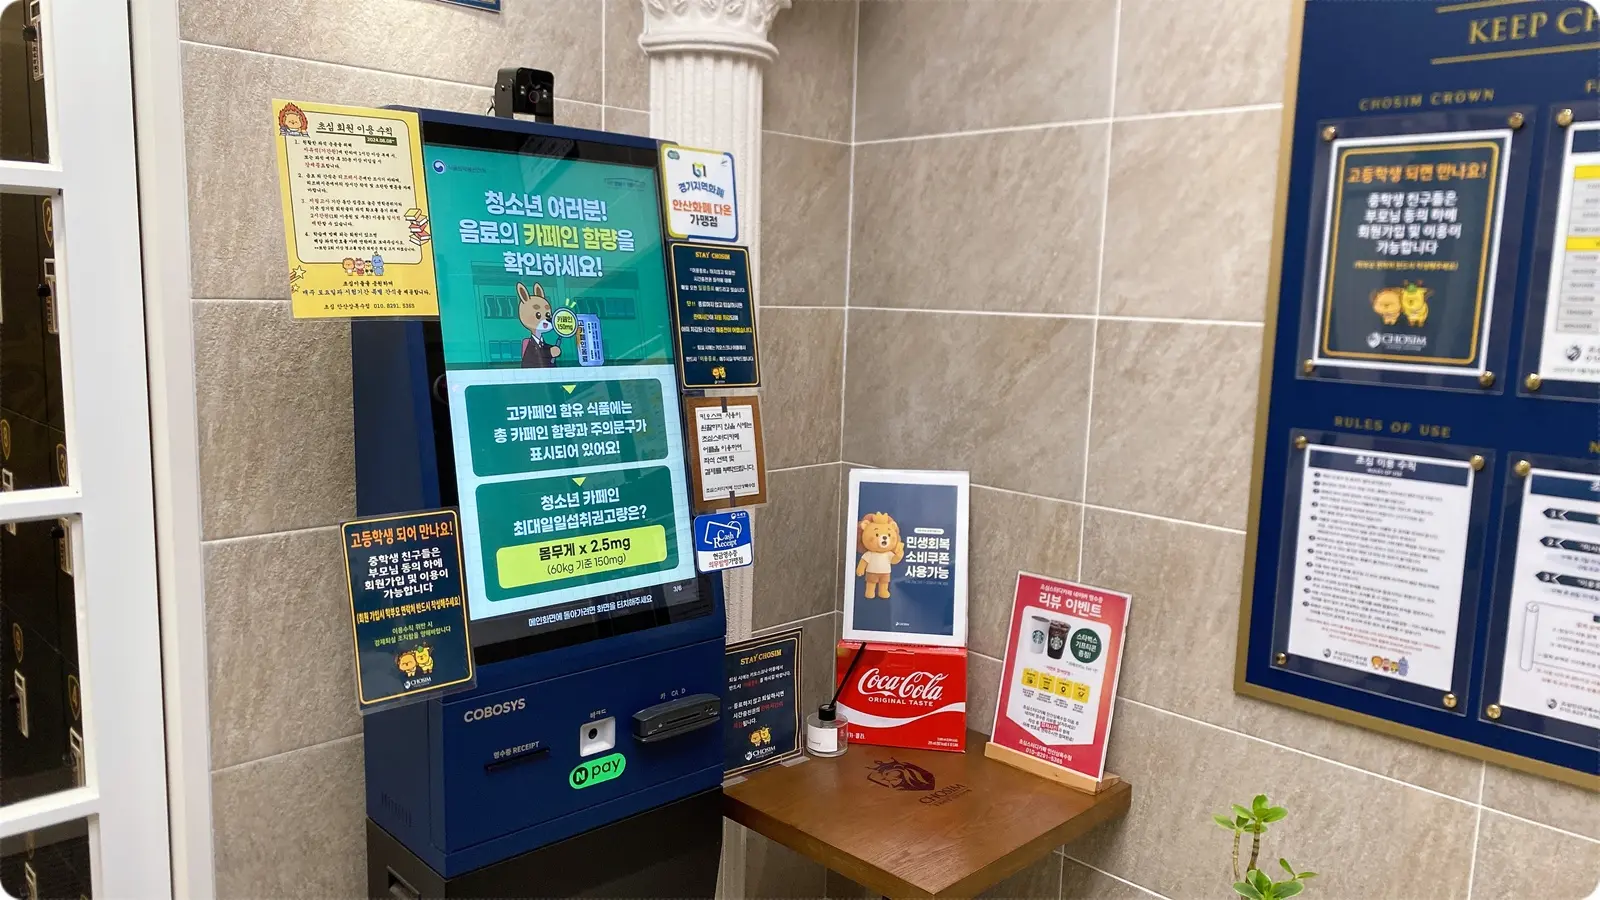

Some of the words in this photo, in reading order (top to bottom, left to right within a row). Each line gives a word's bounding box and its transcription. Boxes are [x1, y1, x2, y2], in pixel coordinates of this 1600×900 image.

[1469, 11, 1548, 44] KEEP
[1358, 94, 1423, 111] CHOSIM
[1430, 88, 1495, 105] CROWN
[317, 121, 334, 131] 초심
[336, 122, 354, 132] 회원
[357, 124, 374, 135] 이용
[1347, 164, 1401, 183] 고등학생
[1404, 163, 1433, 181] 되면
[1436, 160, 1488, 180] 만나요!
[678, 180, 725, 198] 경기지역화폐
[484, 190, 544, 218] 청소년
[548, 196, 608, 222] 여러분!
[672, 199, 712, 214] 안산화폐
[714, 204, 732, 216] 다온
[1367, 192, 1405, 208] 중학생
[1406, 190, 1458, 207] 친구들은
[690, 214, 718, 227] 가맹점
[1364, 208, 1401, 224] 부모님
[1403, 208, 1429, 223] 동의
[1430, 206, 1459, 222] 하에
[459, 218, 519, 245] 음료의
[522, 223, 580, 249] 카페인
[582, 226, 635, 252] 함량을
[1356, 224, 1406, 240] 회원가입
[1408, 224, 1421, 239] 및
[1422, 222, 1463, 239] 이용이
[1375, 239, 1438, 255] 가능합니다
[502, 250, 603, 277] 확인하세요!
[1382, 332, 1427, 346] CHOSIM
[506, 404, 557, 421] 고카페인
[559, 403, 584, 418] 함유
[586, 400, 633, 417] 식품에는
[493, 428, 507, 443] 총
[510, 426, 549, 442] 카페인
[552, 422, 588, 439] 함량과
[590, 418, 647, 435] 주의문구가
[1334, 415, 1384, 432] RULES
[1389, 420, 1412, 434] OF
[1418, 423, 1452, 439] USE
[530, 446, 579, 462] 표시되어
[581, 440, 621, 457] 있어요!
[540, 492, 580, 512] 청소년
[582, 488, 620, 505] 카페인
[513, 504, 647, 537] 최대일일섭취권고량은?
[350, 528, 394, 548] 고등학생
[396, 525, 417, 542] 되어
[419, 521, 453, 540] 만나요!
[713, 537, 737, 549] Receipt
[717, 530, 734, 541] Cash
[906, 536, 950, 550] 민생회복
[368, 552, 399, 567] 중학생
[402, 547, 441, 562] 친구들은
[538, 542, 576, 561] 몸무게
[579, 544, 587, 554] x
[590, 536, 631, 554] 2.5mg
[712, 550, 737, 560] 현금영수증
[905, 550, 950, 565] 소비쿠폰
[368, 564, 399, 578] 부모님
[401, 561, 420, 573] 동의
[423, 558, 443, 569] 하에
[547, 562, 574, 576] (60kg
[576, 558, 593, 571] 기준
[594, 554, 627, 567] 150mg)
[904, 566, 949, 579] 사용가능
[364, 575, 405, 590] 회원가입
[408, 572, 417, 583] 및
[420, 568, 449, 581] 이용이
[384, 582, 433, 599] 가능합니다
[356, 612, 369, 624] (회원
[370, 610, 385, 621] 가입시
[386, 606, 400, 619] 학부모
[400, 604, 416, 616] 연락처
[416, 602, 431, 613] 반드시
[431, 596, 461, 610] 작성해주세요)
[528, 612, 563, 627] 메인화면에
[564, 606, 596, 622] 돌아가려면
[596, 602, 616, 615] 화면을
[616, 594, 653, 610] 터치해주세요
[1038, 592, 1061, 610] 리뷰
[1066, 598, 1102, 617] 이벤트
[415, 622, 426, 630] 위반
[1076, 634, 1098, 644] 스타벅스
[1076, 641, 1097, 653] 기프티콘
[740, 654, 759, 665] STAY
[758, 649, 782, 660] CHOSIM
[1078, 650, 1091, 659] 증정!
[410, 676, 431, 685] CHOSIM
[858, 668, 949, 700] Coca-Cola
[868, 696, 906, 705] ORIGINAL
[464, 698, 526, 723] COBOSYS
[494, 748, 512, 759] 영수증
[512, 740, 539, 754] RECEIPT
[752, 746, 776, 755] CHOSIM
[591, 757, 621, 779] pay
